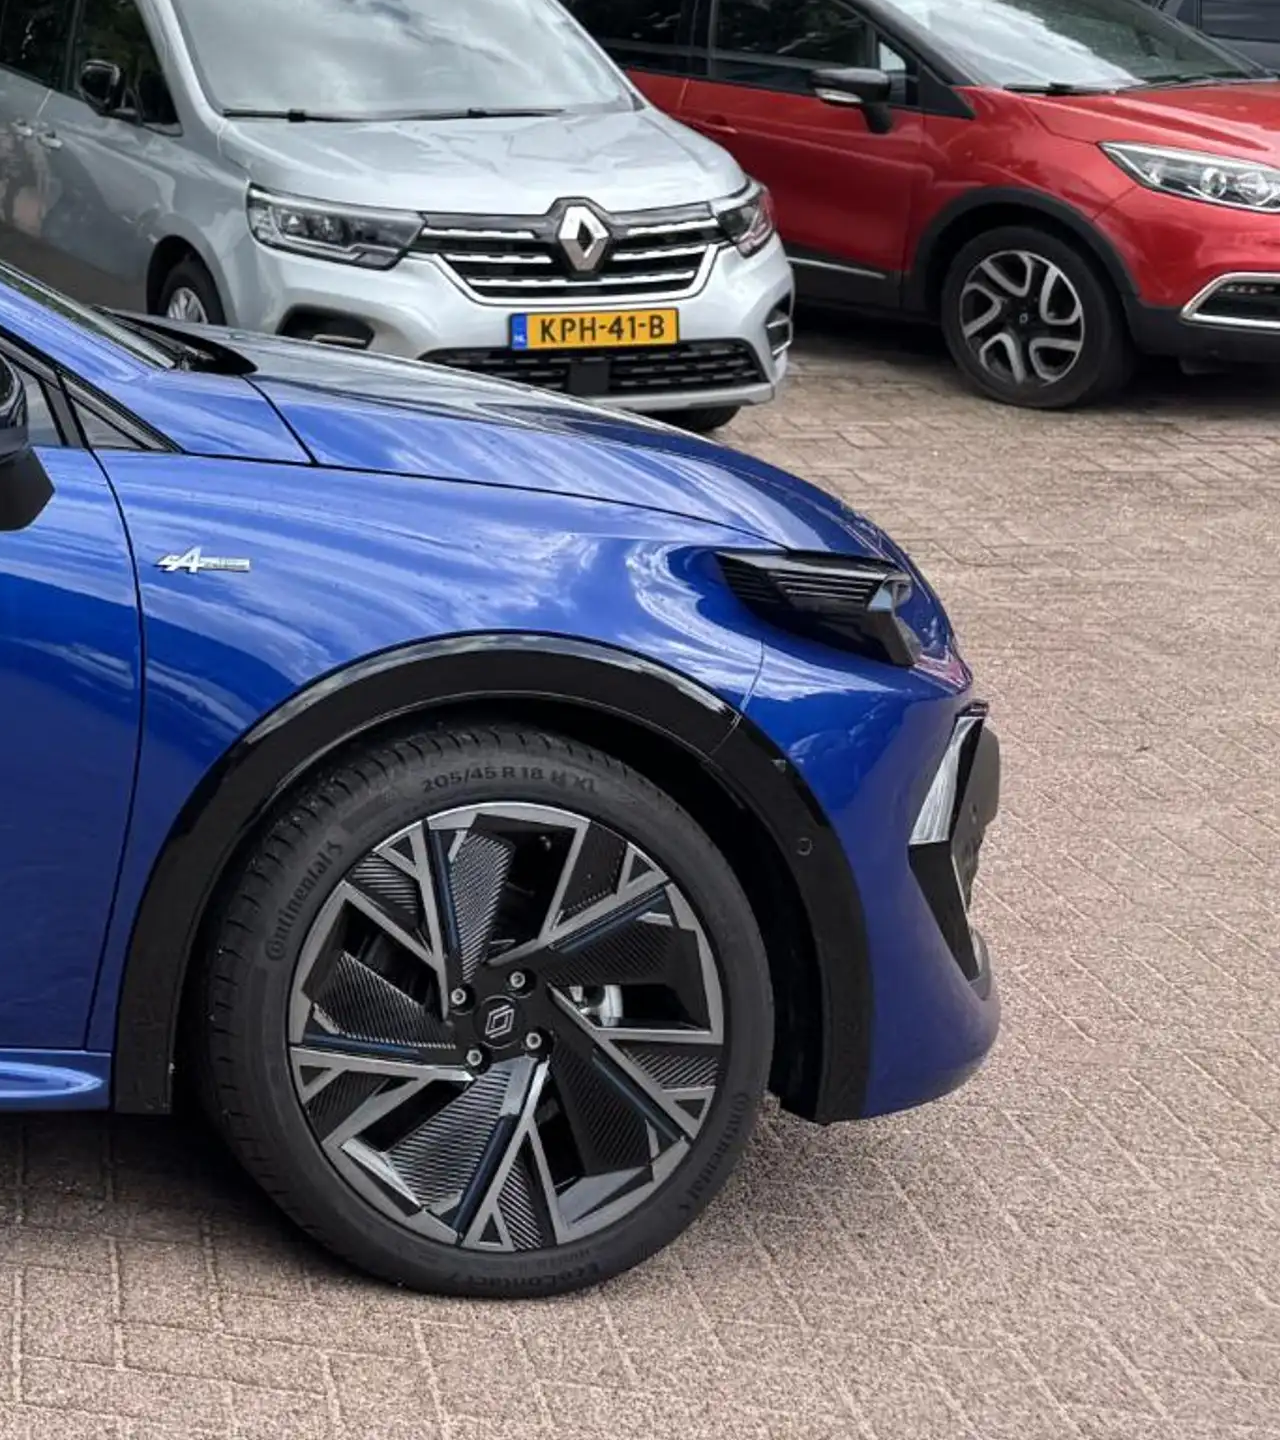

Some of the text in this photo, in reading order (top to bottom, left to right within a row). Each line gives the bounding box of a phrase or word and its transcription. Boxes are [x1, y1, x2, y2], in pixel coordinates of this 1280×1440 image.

[541, 315, 665, 344] KPH-41-B
[422, 766, 497, 793] 205/45
[502, 766, 517, 779] R
[523, 766, 545, 780] 18
